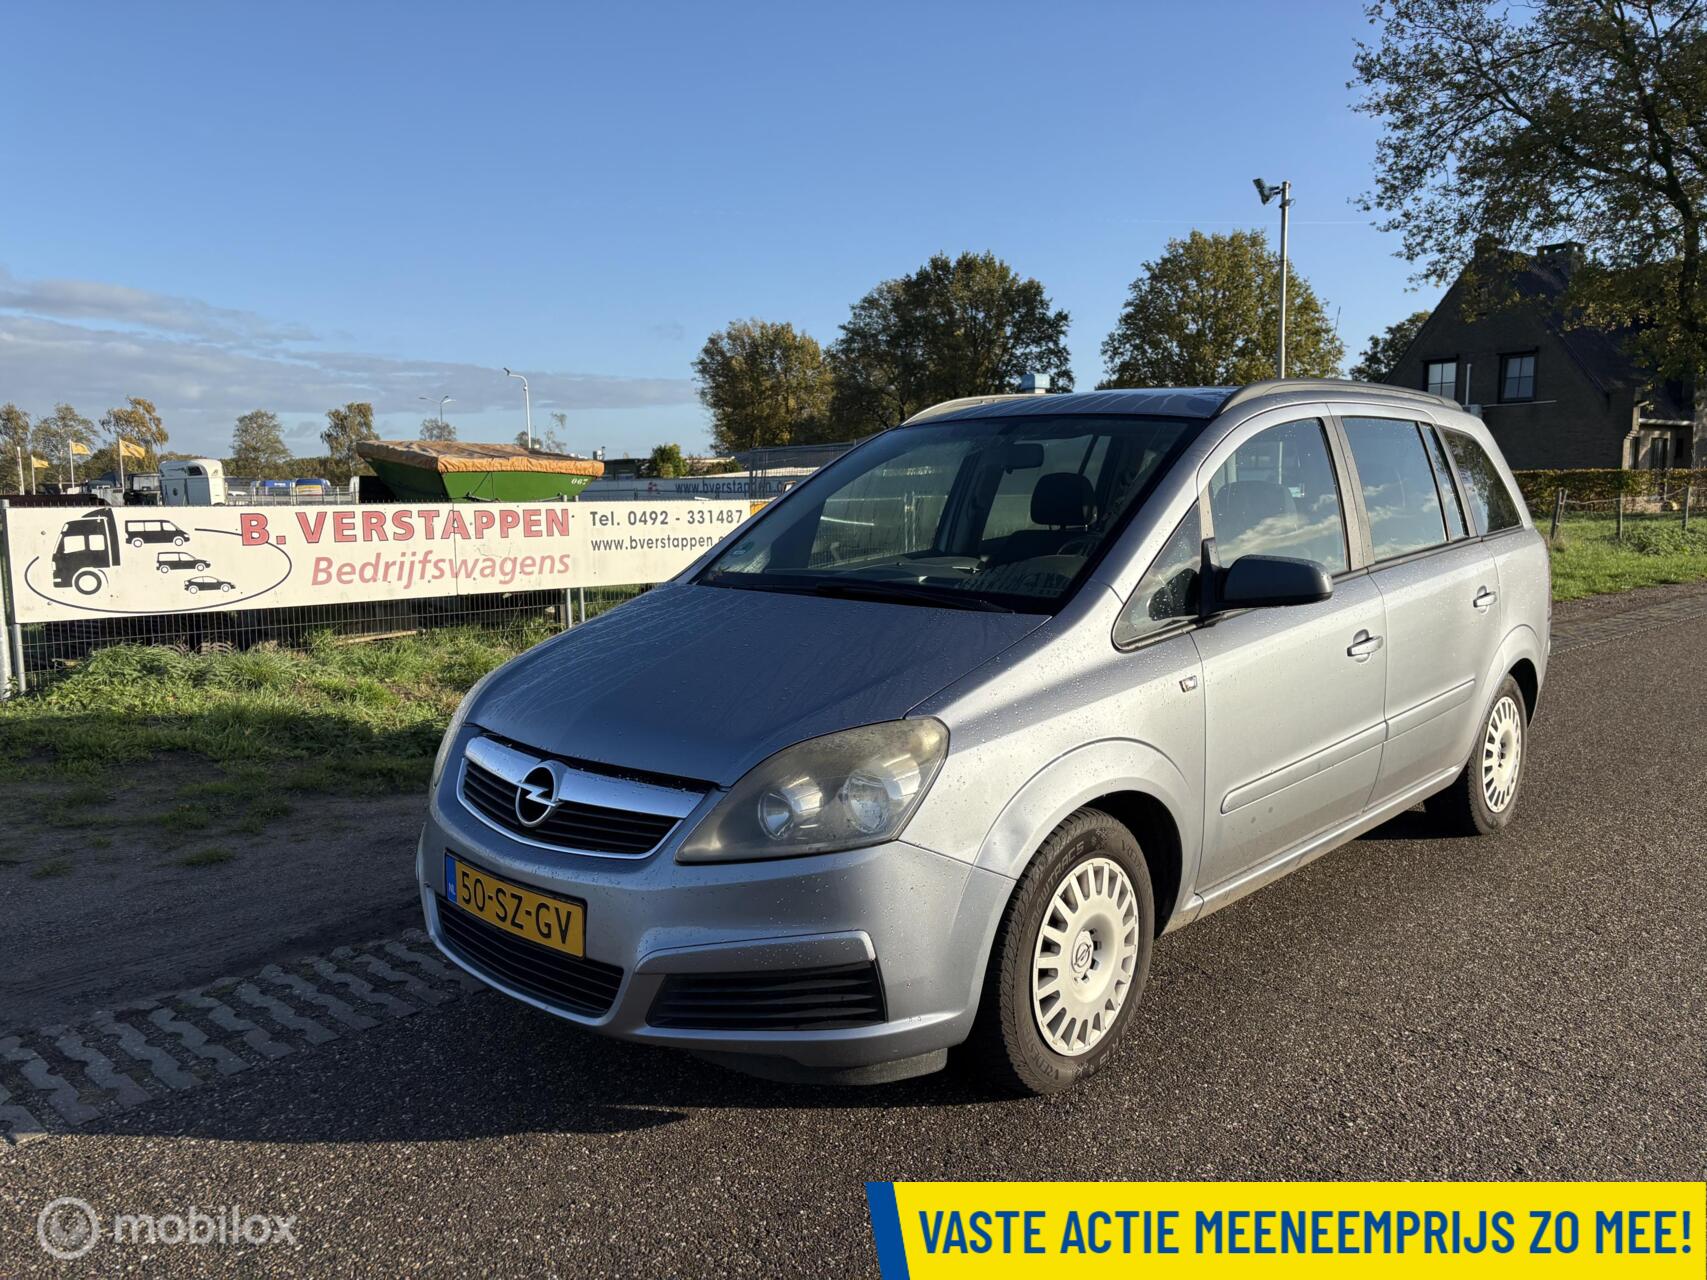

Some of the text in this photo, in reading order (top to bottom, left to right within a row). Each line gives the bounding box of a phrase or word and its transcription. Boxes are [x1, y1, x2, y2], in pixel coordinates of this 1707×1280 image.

[240, 508, 570, 546] B. VERSTAPPEN
[590, 511, 620, 526] Tel.
[627, 510, 669, 526] 0492
[687, 509, 743, 525] 331487
[311, 550, 570, 589] Bedrijfswagens
[461, 870, 572, 945] 50-SZ-GV
